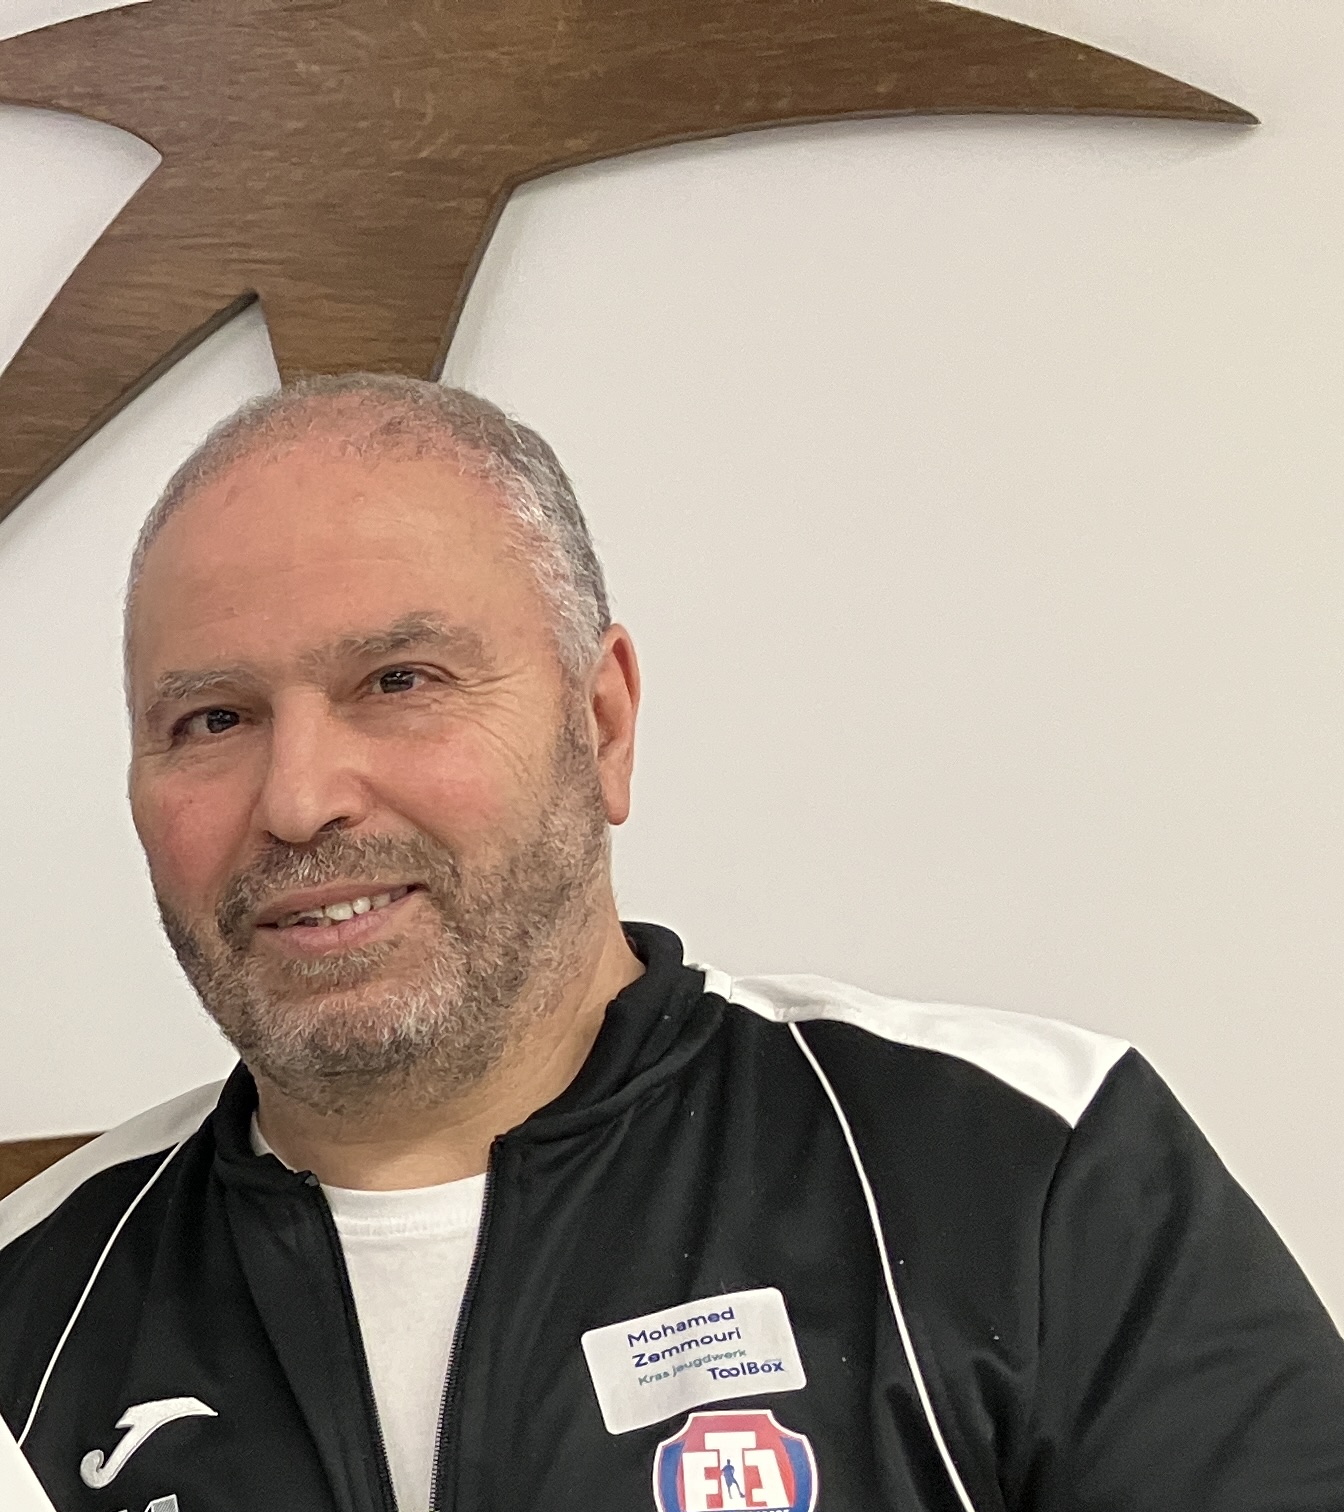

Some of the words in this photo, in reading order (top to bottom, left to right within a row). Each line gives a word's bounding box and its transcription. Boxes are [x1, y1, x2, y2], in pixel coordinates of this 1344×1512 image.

[627, 1306, 736, 1348] Mohamed
[632, 1326, 742, 1368] Zemmouri
[707, 1359, 785, 1381] ToolBox
